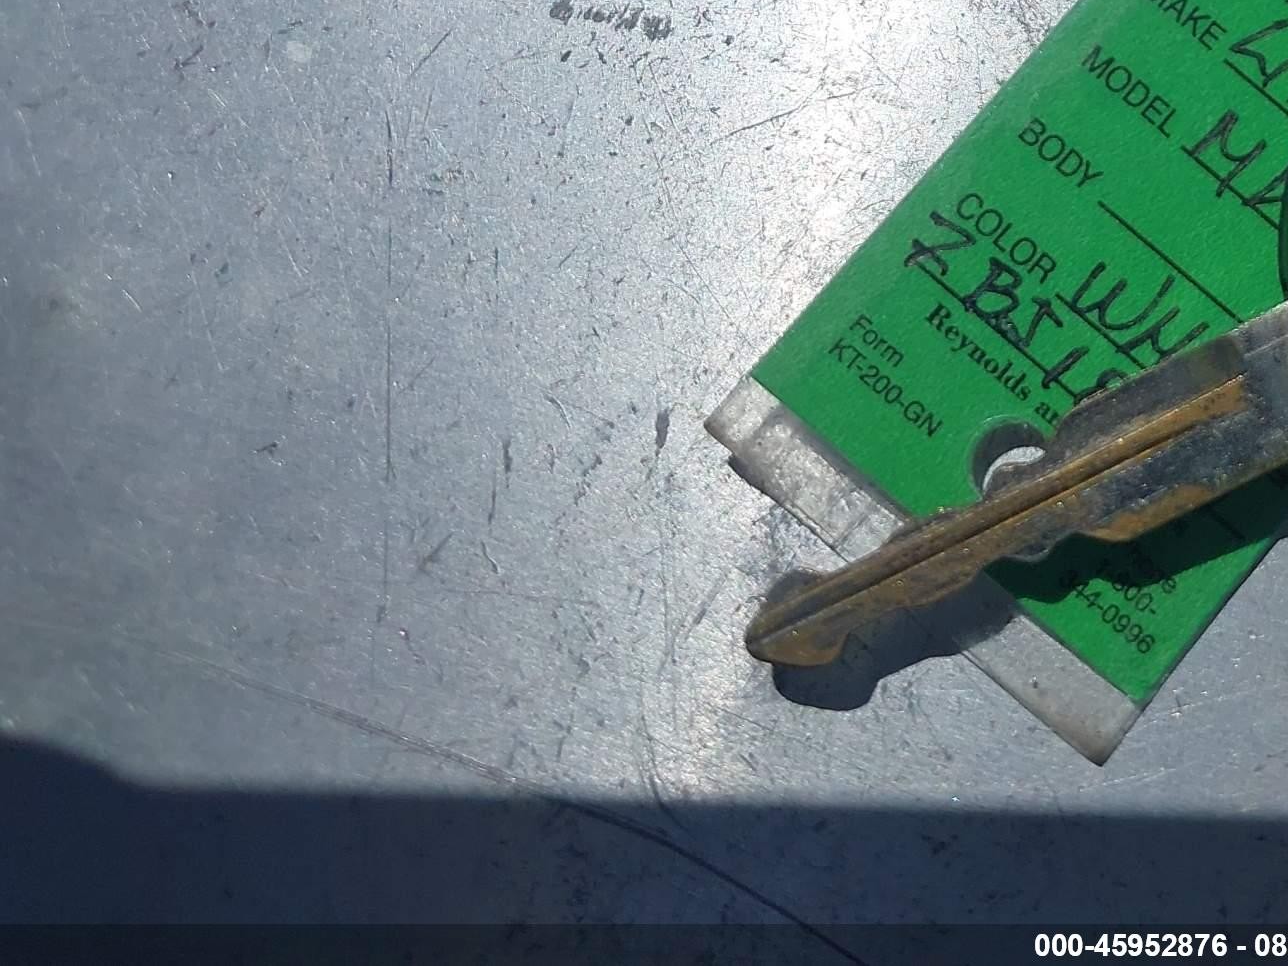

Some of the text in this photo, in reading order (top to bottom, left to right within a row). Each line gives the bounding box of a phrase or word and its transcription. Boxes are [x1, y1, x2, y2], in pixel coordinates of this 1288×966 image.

[1080, 44, 1178, 139] MODEL
[1017, 117, 1105, 190] BODY
[954, 191, 1058, 285] COLOR
[848, 313, 905, 368] Form
[924, 301, 1032, 402] Reynolds
[827, 343, 944, 439] KT-200-GN
